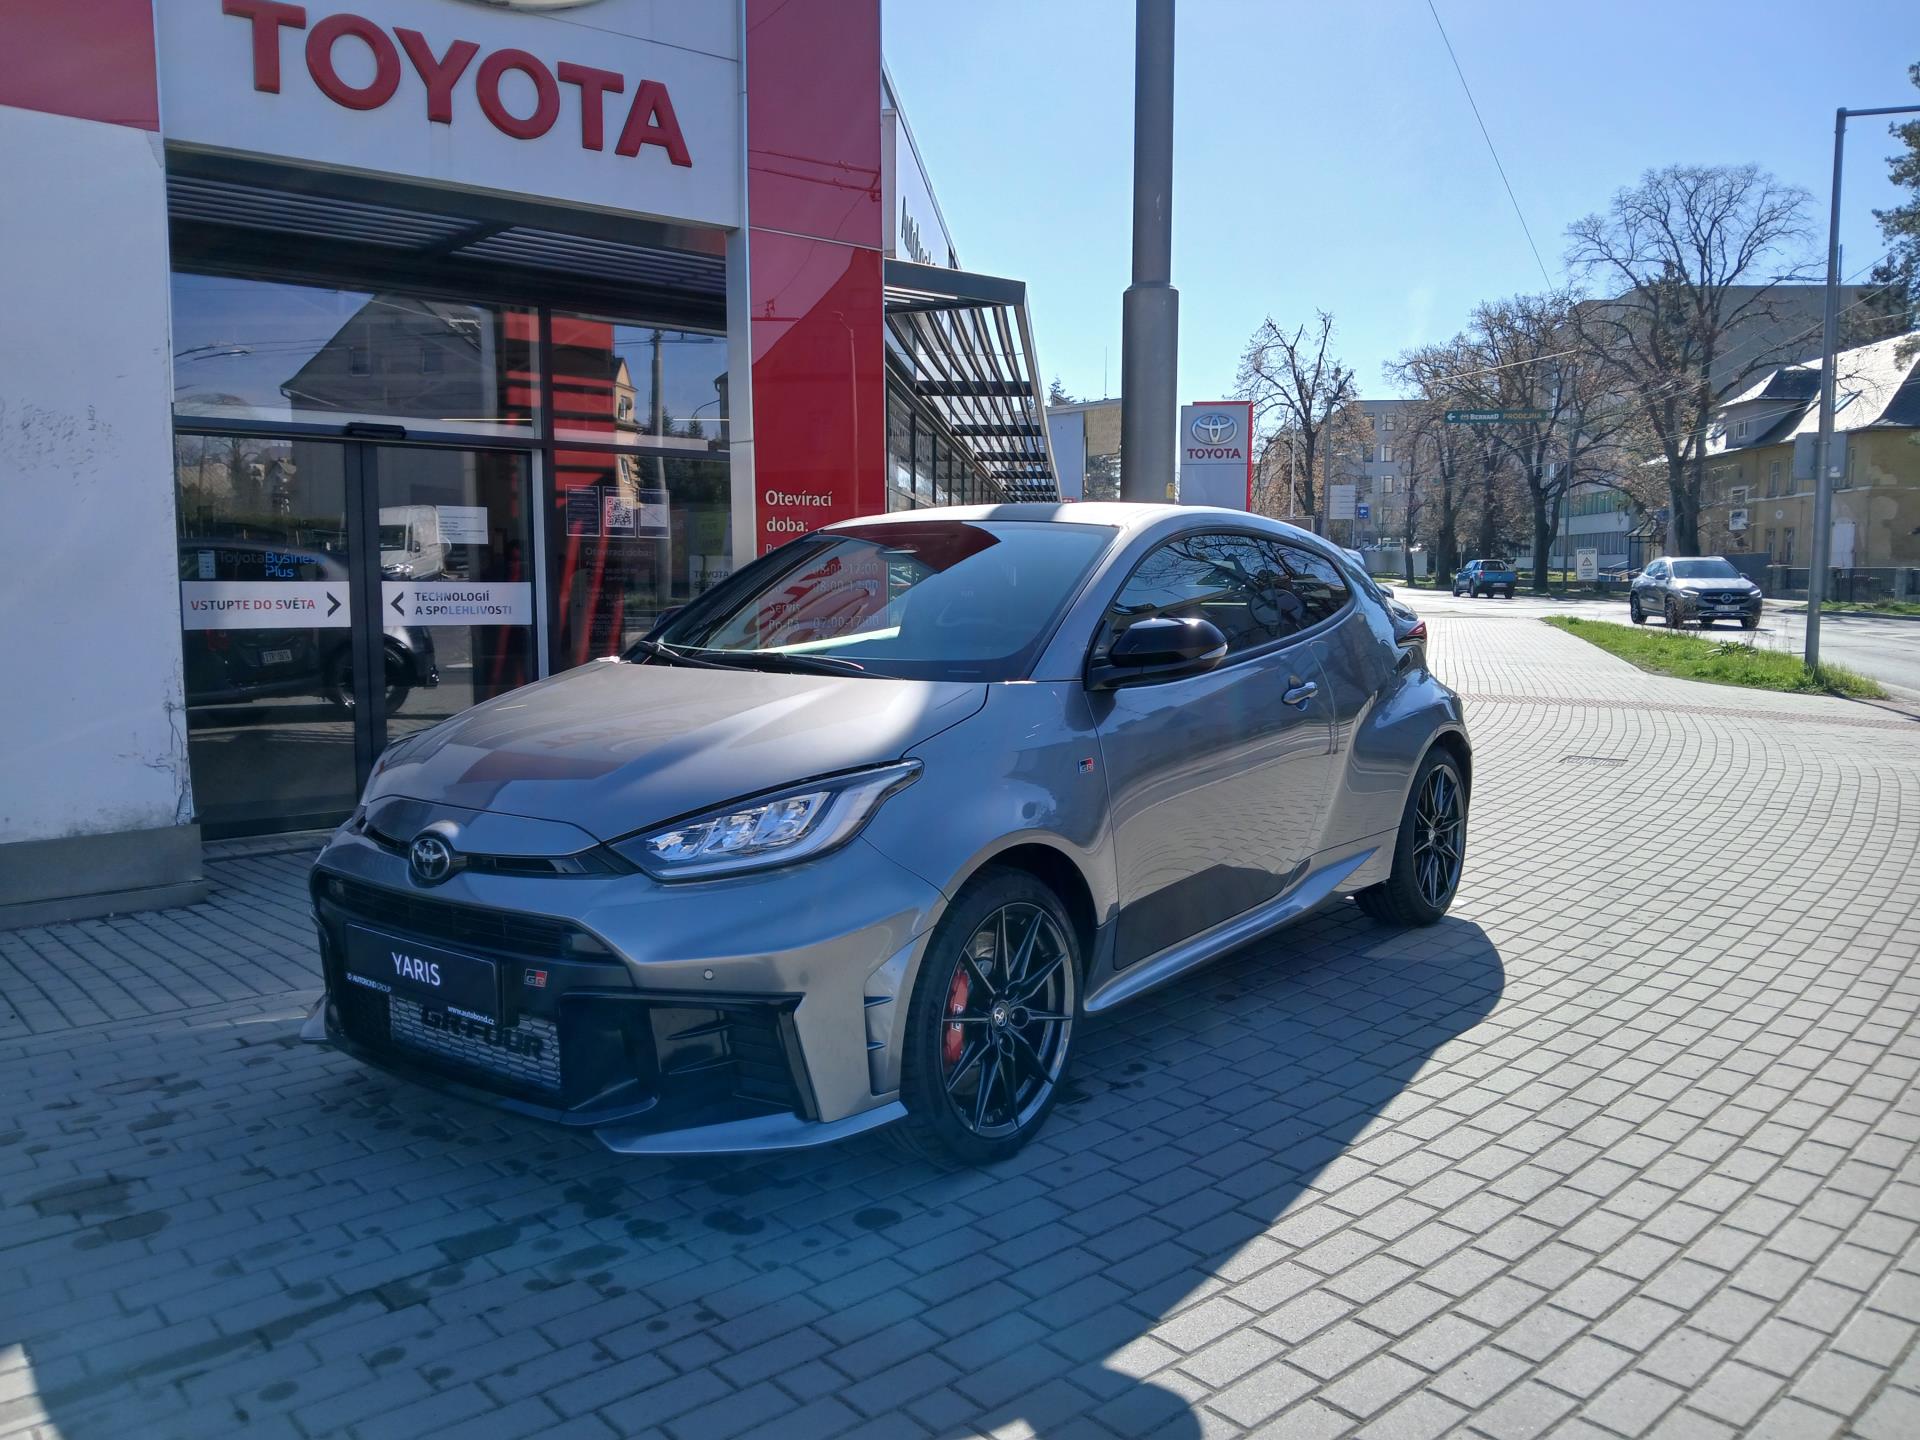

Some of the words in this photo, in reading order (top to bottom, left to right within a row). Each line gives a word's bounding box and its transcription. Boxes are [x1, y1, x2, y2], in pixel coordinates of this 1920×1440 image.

[222, 0, 692, 168] TOYOTA
[1187, 448, 1241, 459] TOYOTA
[765, 490, 833, 507] Otevírací
[766, 516, 809, 532] doba:
[265, 565, 295, 578] Plus
[414, 590, 490, 602] TECHNOLOGIÍ
[190, 599, 250, 611] VSTUPTE
[253, 599, 273, 610] DO
[275, 597, 316, 610] SVĚTA
[415, 605, 424, 616] A
[426, 605, 512, 616] SPOLEHLIVOSTI
[391, 952, 441, 986] YARIS
